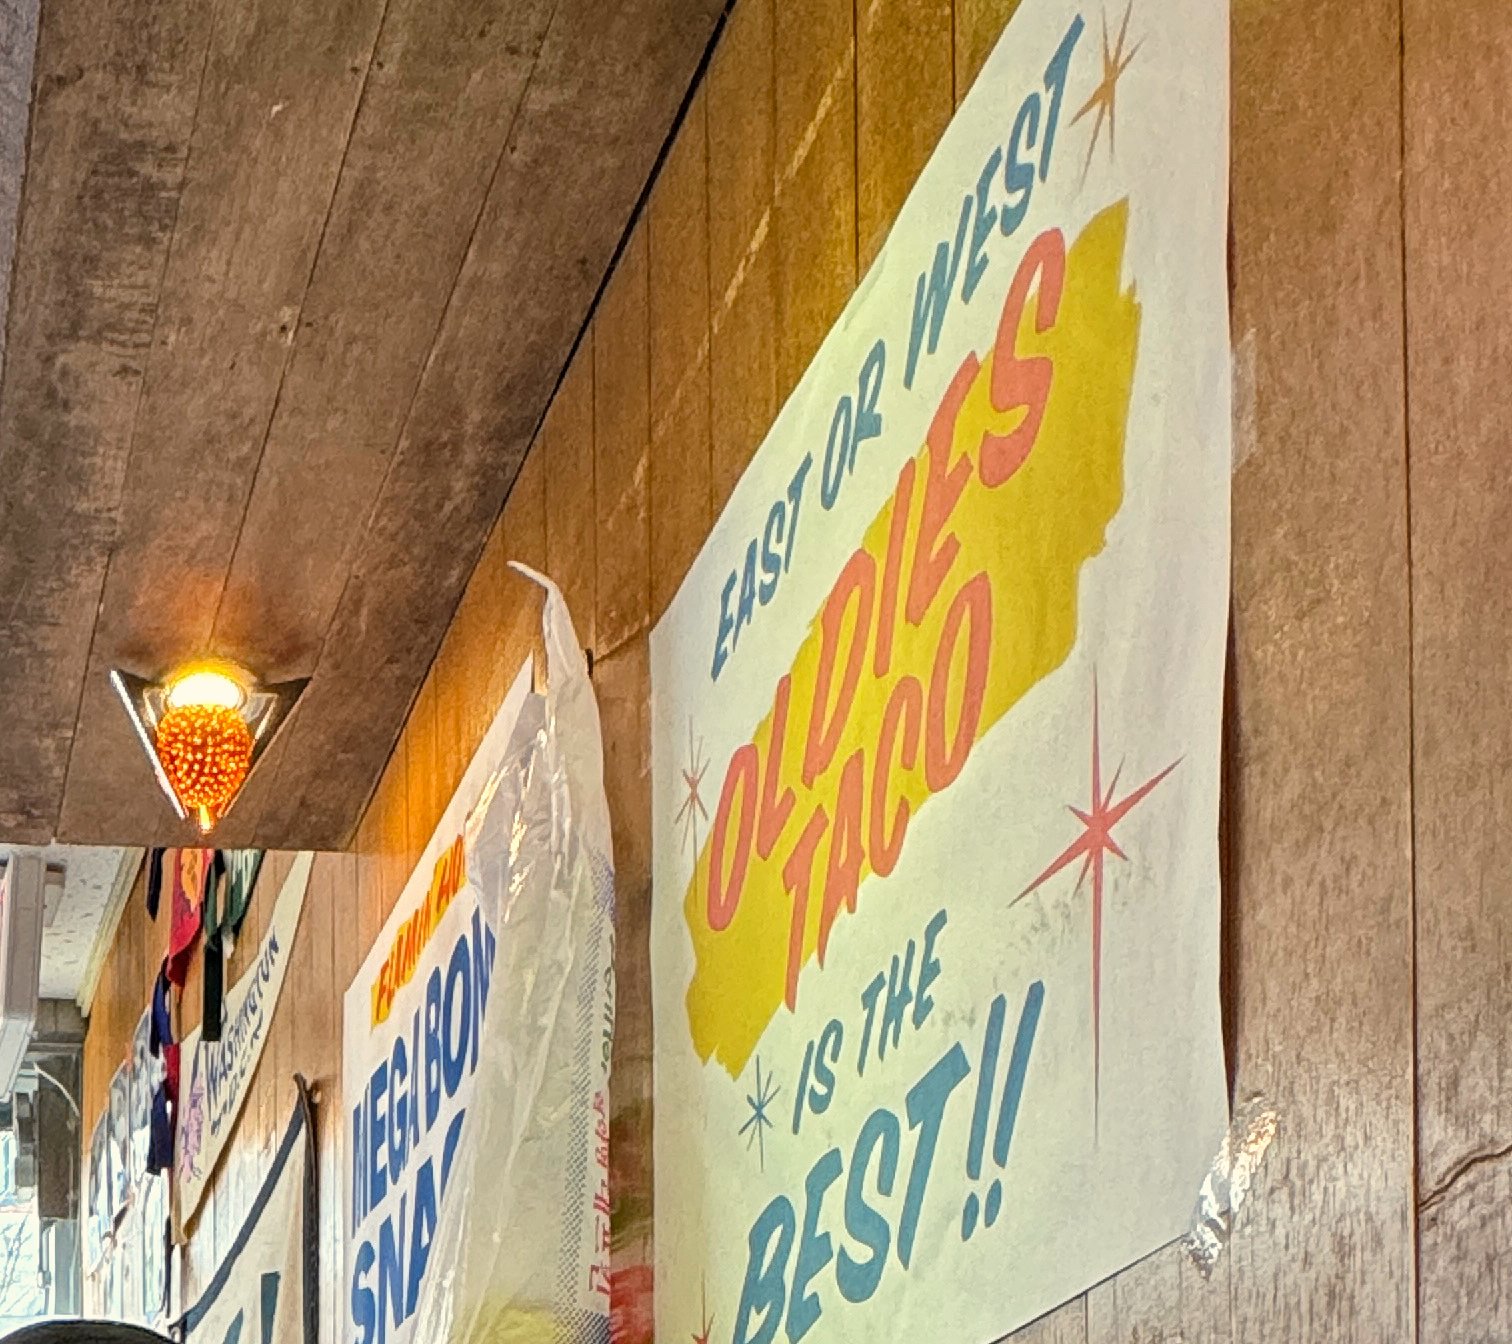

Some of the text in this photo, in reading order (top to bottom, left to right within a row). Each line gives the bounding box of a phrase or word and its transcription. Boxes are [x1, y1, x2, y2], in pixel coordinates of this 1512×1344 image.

[711, 13, 1086, 682] EAST OR WEST
[707, 227, 1067, 932] OLDIES
[784, 571, 992, 1012] TACO
[351, 1003, 420, 1240] MEGA
[791, 908, 948, 1135] IS THE
